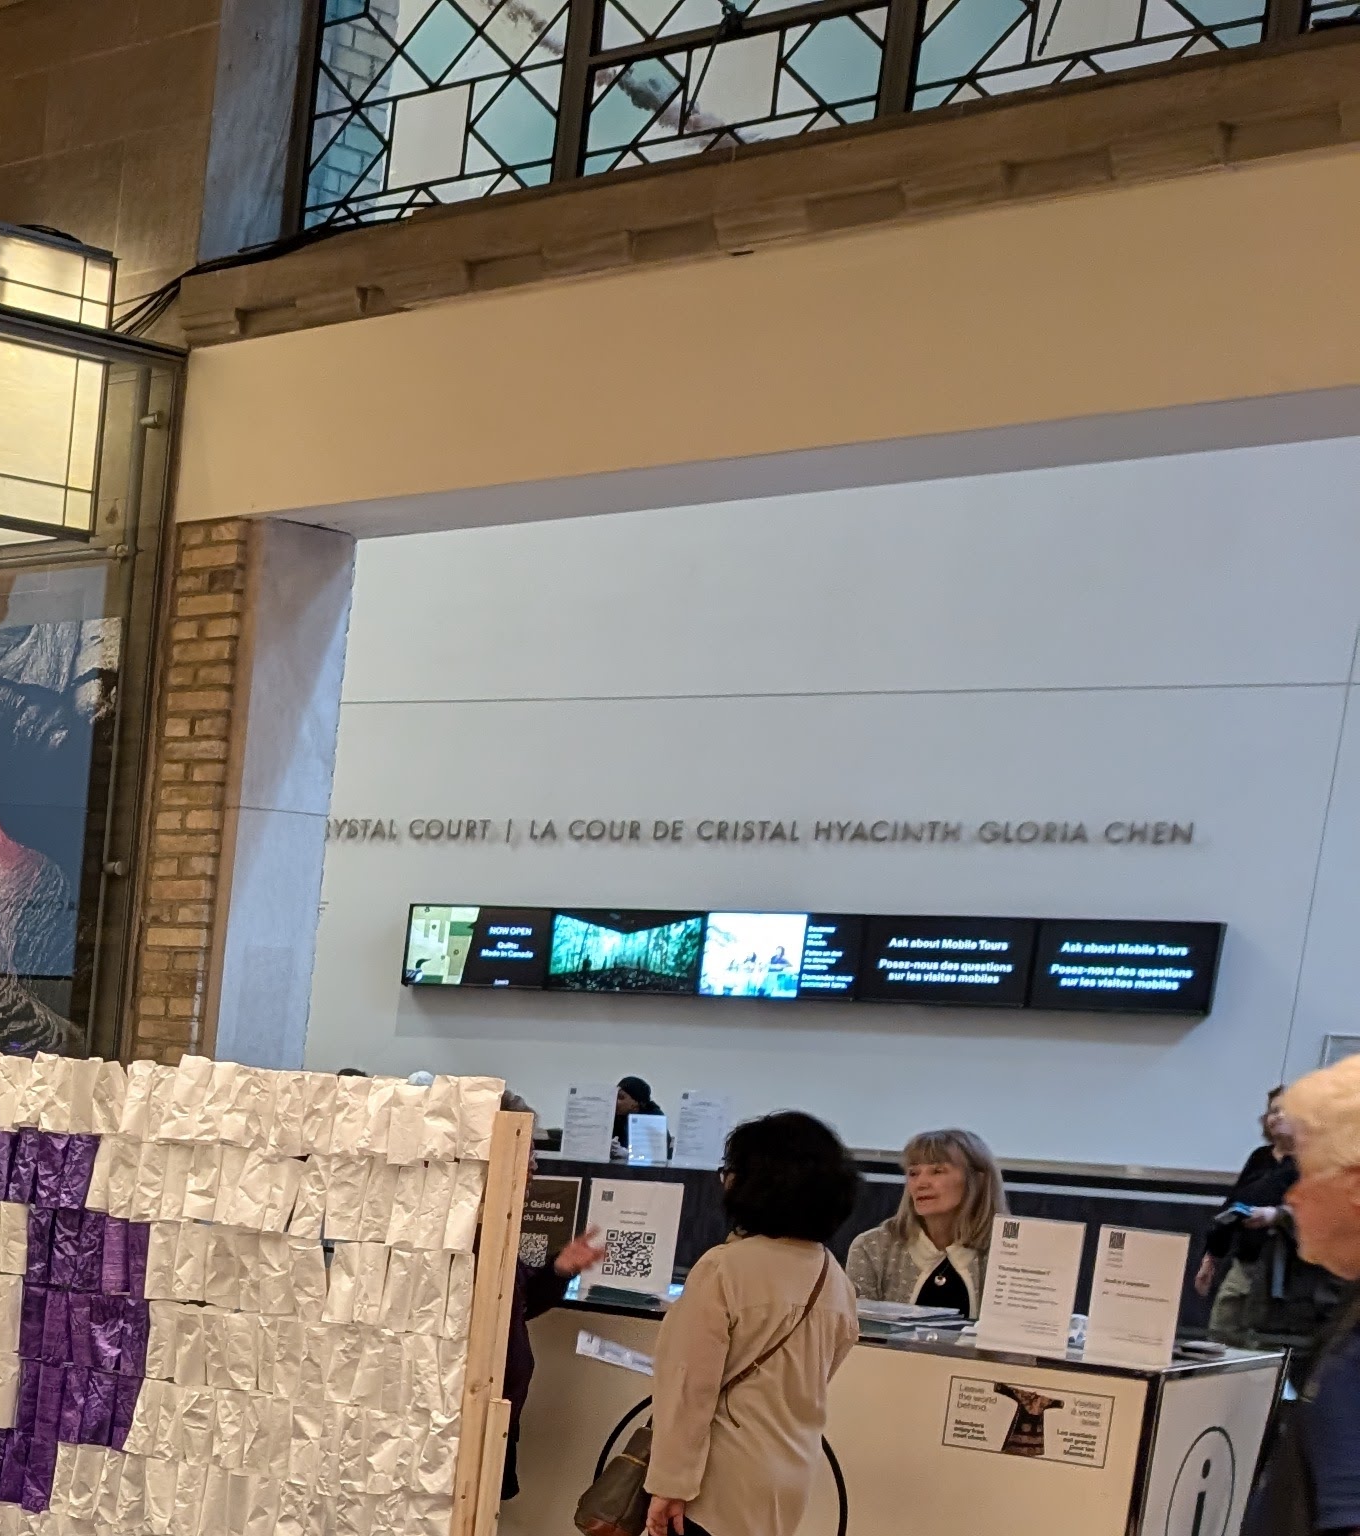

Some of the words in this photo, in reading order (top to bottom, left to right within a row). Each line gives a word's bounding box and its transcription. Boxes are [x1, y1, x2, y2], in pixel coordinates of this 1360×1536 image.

[327, 818, 398, 840] YSTAL
[409, 818, 490, 841] COURT
[530, 819, 557, 841] LA
[568, 819, 641, 841] COUR
[653, 820, 684, 842] DE
[696, 820, 800, 842] CRISTAL
[814, 820, 962, 843] HYACINTH
[978, 821, 1089, 844] GLORIA
[1104, 821, 1195, 845] CHEN
[488, 926, 509, 935] NOW
[510, 926, 532, 936] OPEN
[888, 938, 908, 949] Ask
[910, 939, 940, 949] about
[941, 939, 977, 950] Mobile
[979, 940, 1008, 951] Tours
[1060, 942, 1083, 953] Ask
[1084, 943, 1116, 954] about
[1117, 943, 1155, 955] Mobile
[1157, 944, 1189, 956] Tours
[508, 950, 533, 959] Canada
[878, 958, 939, 971] Posez-nous
[940, 961, 959, 971] des
[960, 962, 1013, 973] questions
[1050, 963, 1114, 976] Posez-nous
[1115, 966, 1136, 977] des
[1137, 968, 1193, 979] questions
[888, 972, 905, 980] sur
[906, 971, 921, 981] les
[923, 972, 956, 982] visites
[958, 973, 999, 984] mobiles
[1060, 978, 1079, 987] sur
[1079, 977, 1095, 987] les
[1097, 978, 1133, 988] visites
[1134, 979, 1180, 991] mobiles
[530, 1200, 561, 1210] Guides
[535, 1213, 564, 1223] Musée
[959, 1384, 984, 1394] Leave
[958, 1393, 972, 1401] the
[973, 1395, 997, 1404] world
